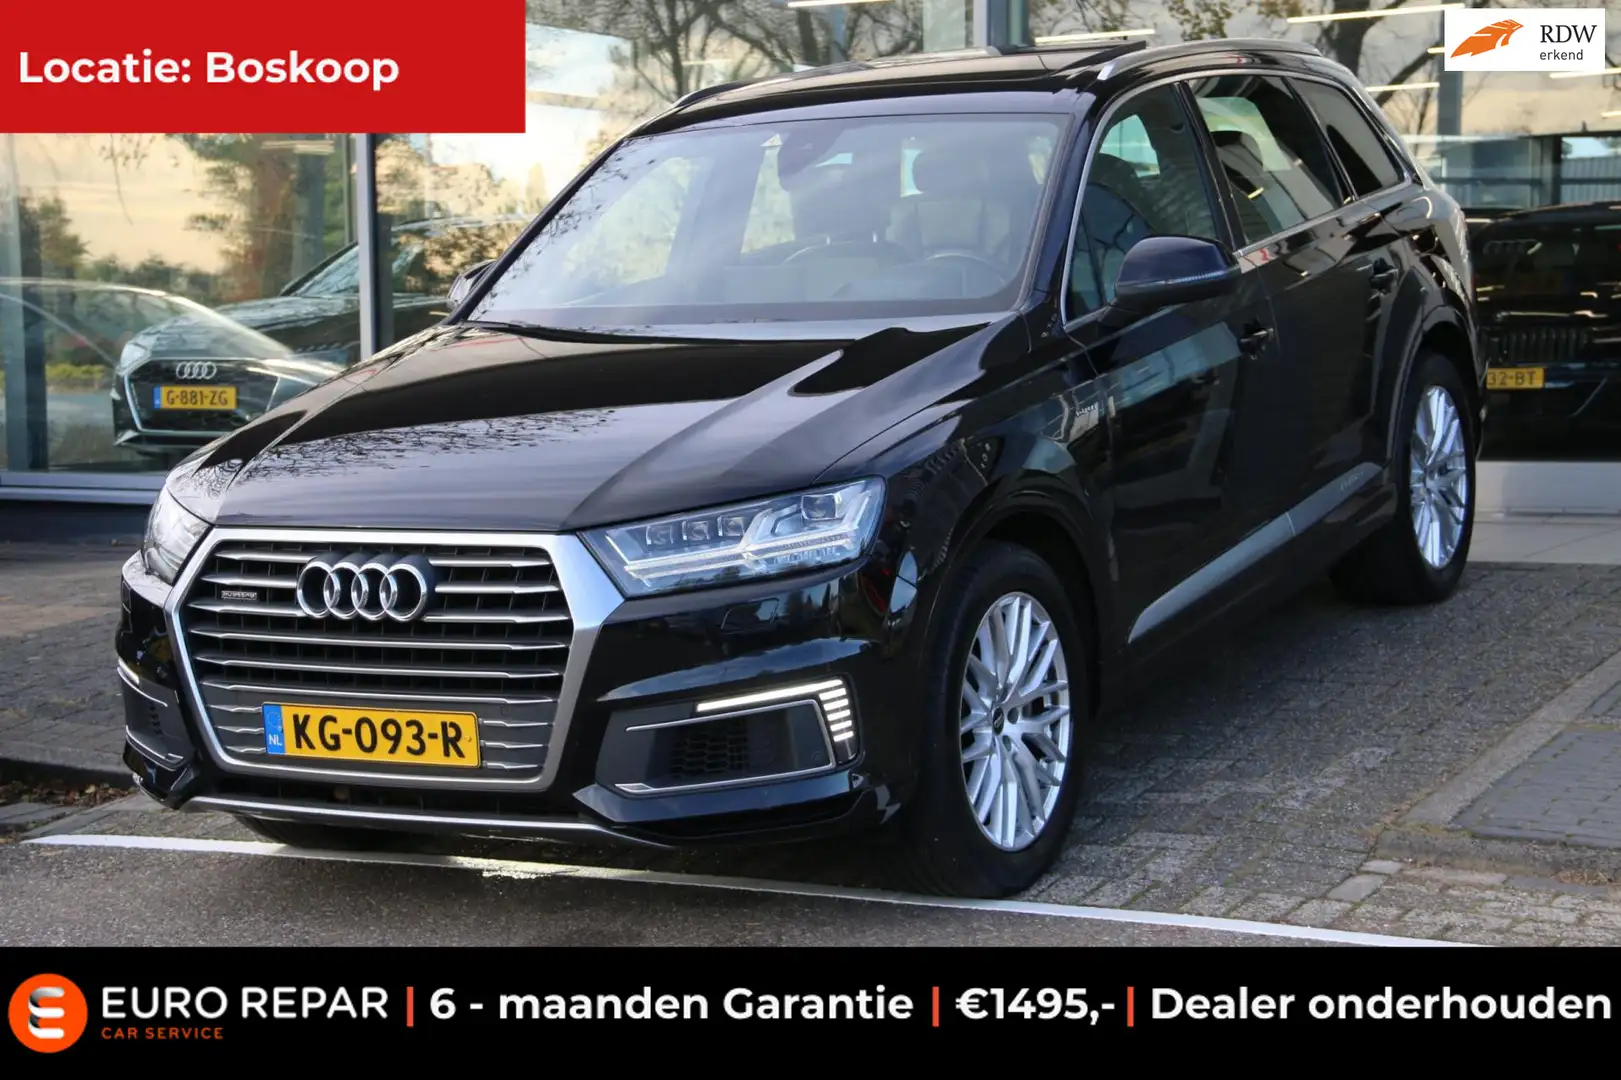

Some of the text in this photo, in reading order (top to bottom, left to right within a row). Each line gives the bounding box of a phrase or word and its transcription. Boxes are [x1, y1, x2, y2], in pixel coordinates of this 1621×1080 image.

[166, 390, 228, 405] G-881-ZG
[268, 734, 283, 746] NL
[292, 713, 466, 758] KG-093-R
